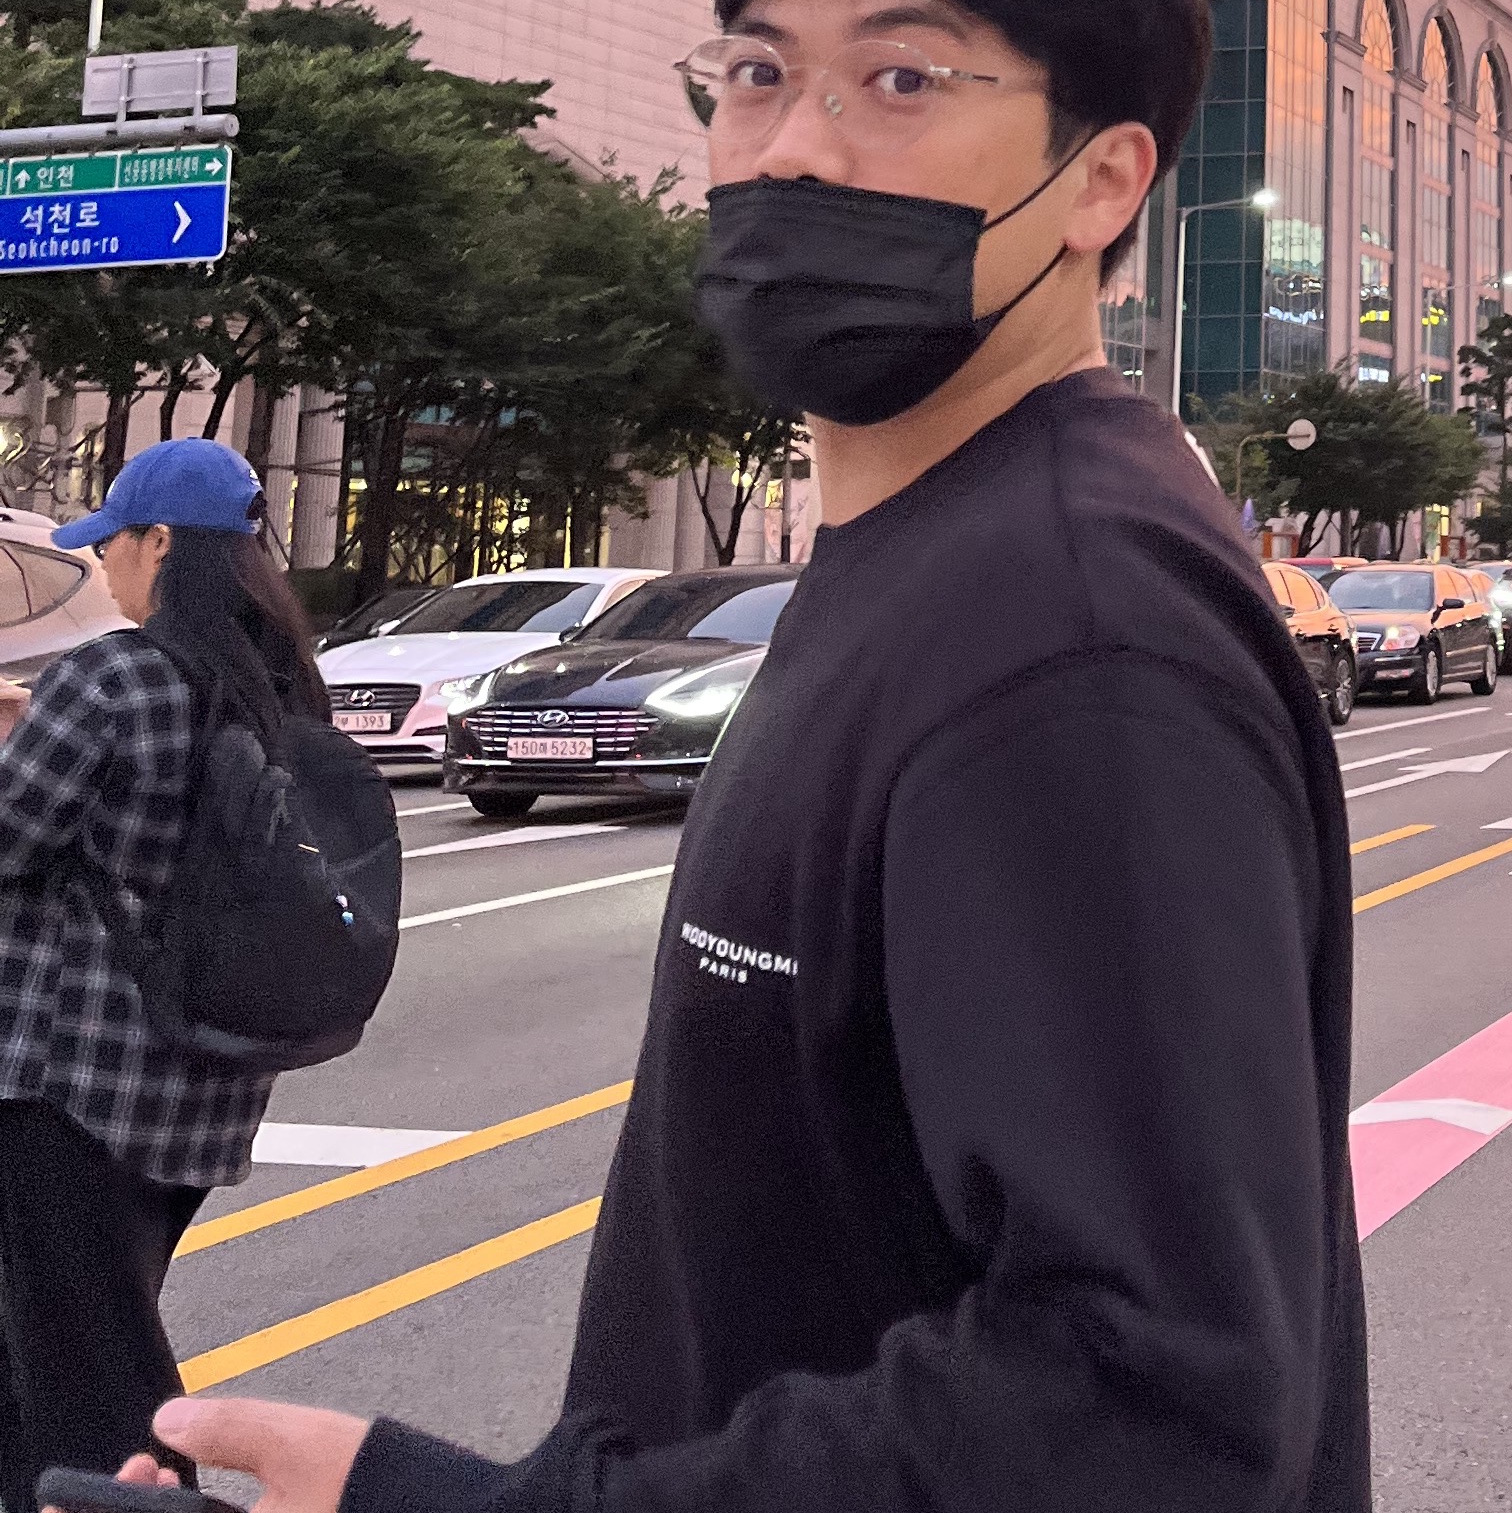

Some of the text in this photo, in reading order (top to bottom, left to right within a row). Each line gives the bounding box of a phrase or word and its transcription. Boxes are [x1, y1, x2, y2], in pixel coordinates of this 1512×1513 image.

[36, 164, 74, 189] 인천
[20, 201, 100, 236] 석천로
[355, 714, 385, 729] 1393
[550, 740, 587, 756] 5232
[699, 956, 748, 984] PARIS
